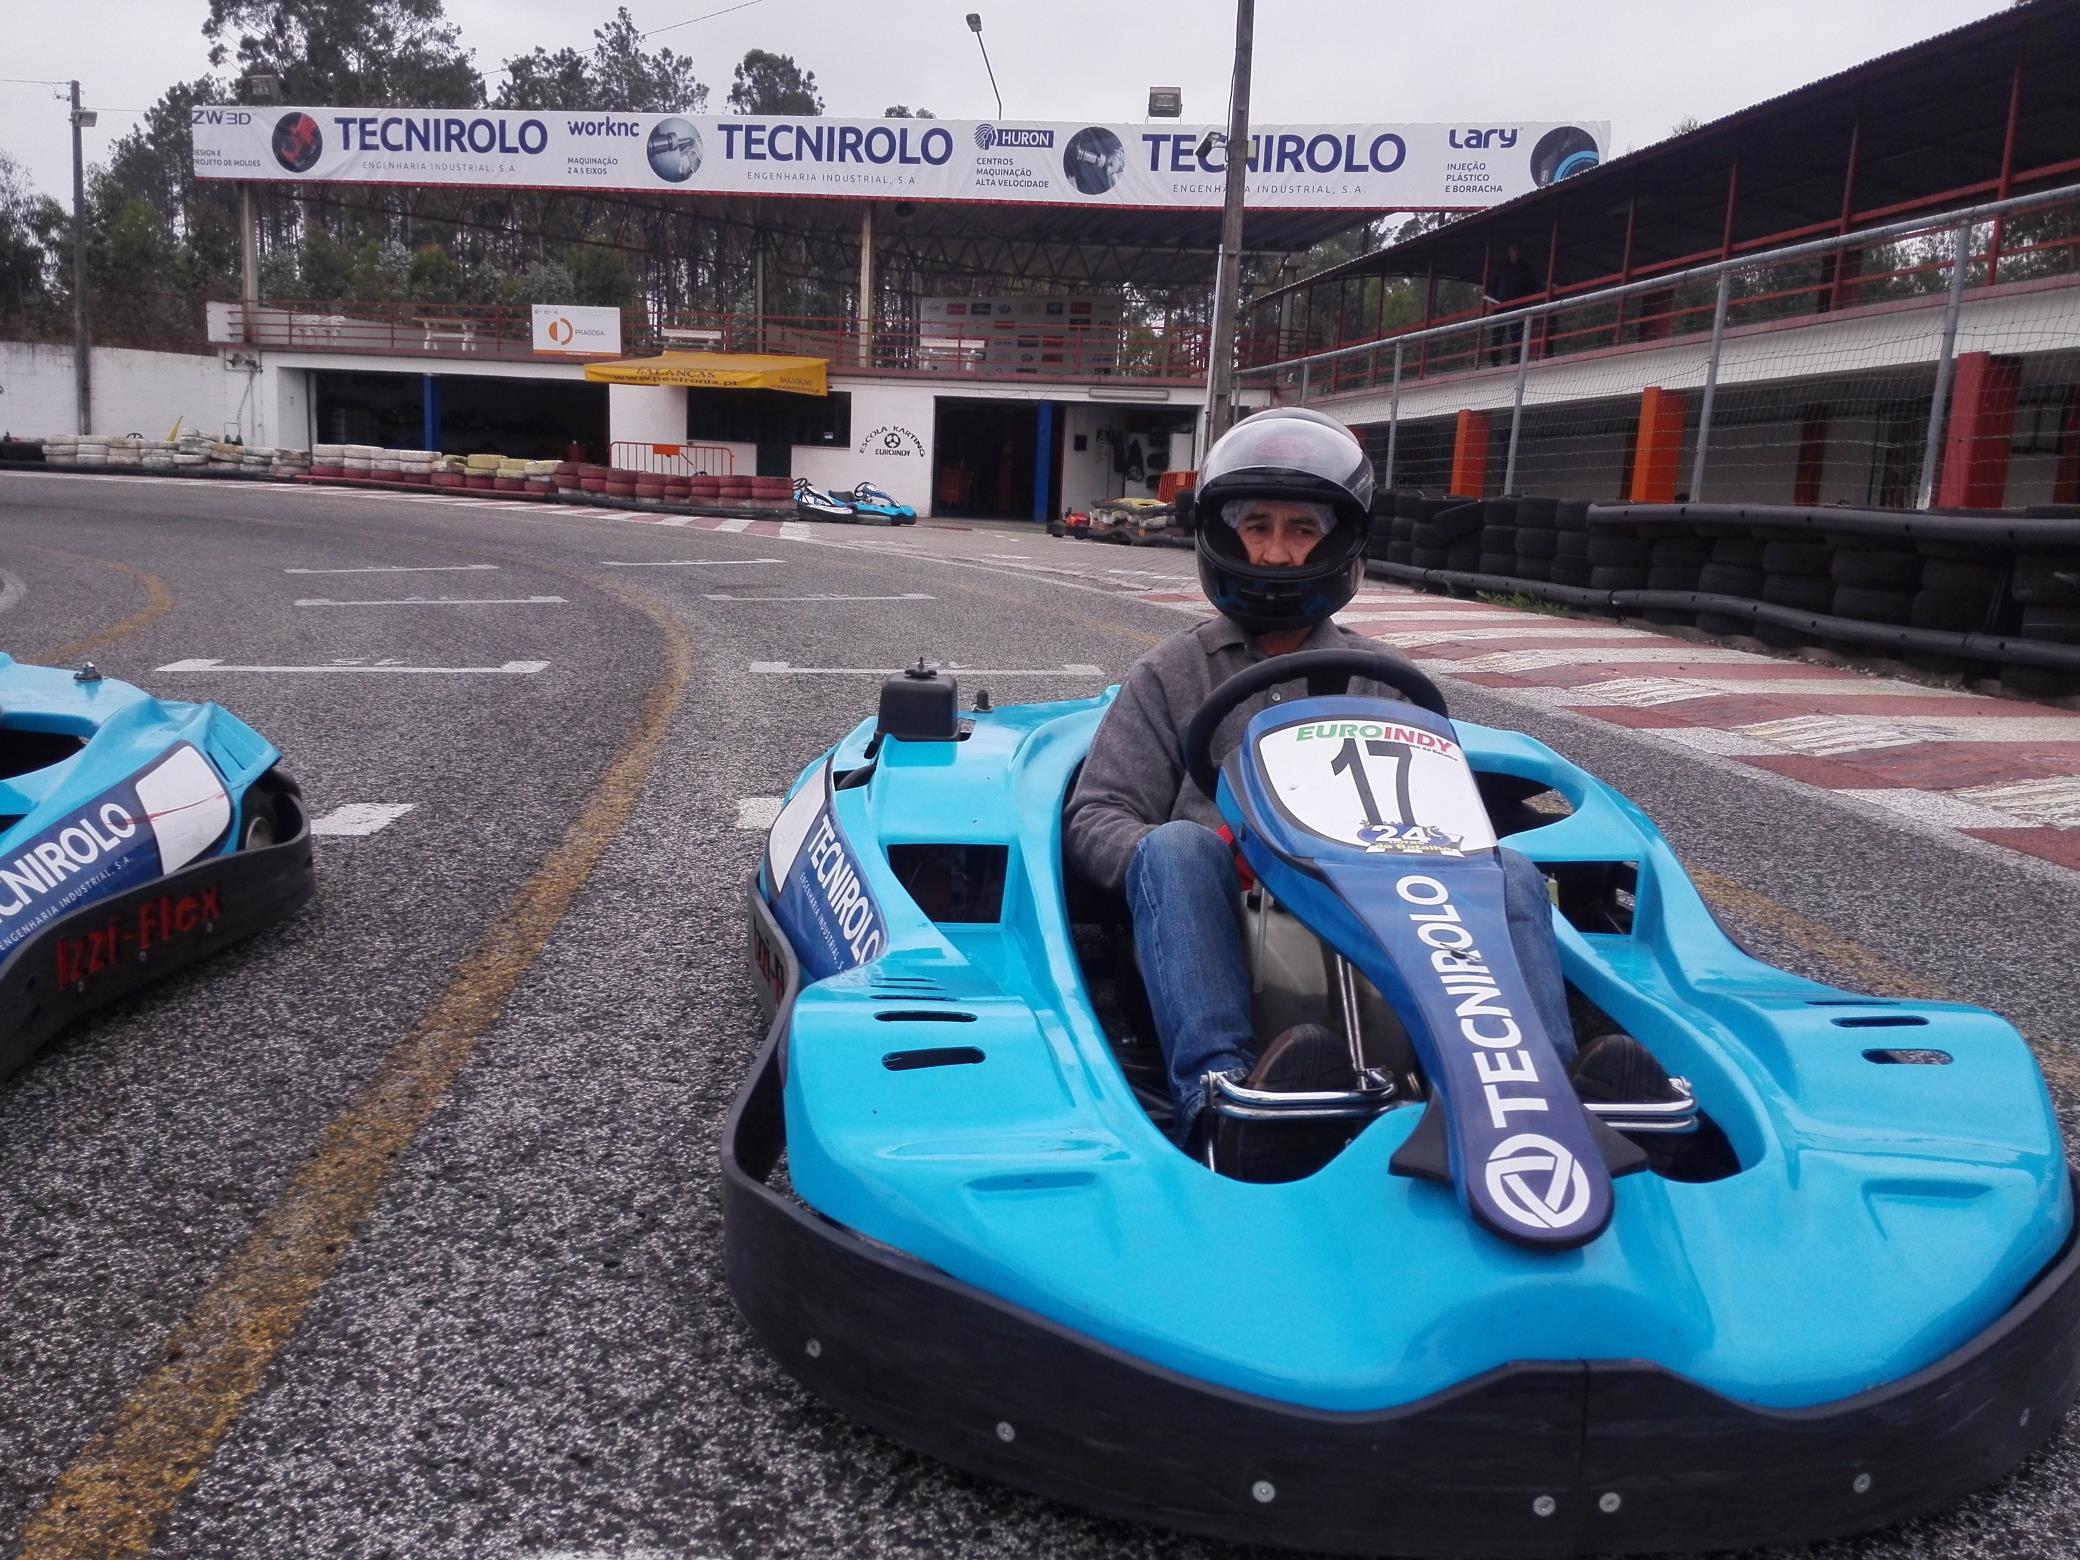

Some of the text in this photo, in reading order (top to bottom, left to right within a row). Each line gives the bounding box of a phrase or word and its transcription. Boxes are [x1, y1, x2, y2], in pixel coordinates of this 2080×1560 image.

[192, 110, 252, 125] ZW3D
[567, 116, 640, 137] worknc
[334, 117, 548, 155] TECNIROLO
[1002, 131, 1049, 146] HURON
[717, 123, 953, 165] TECNIROLO
[362, 161, 427, 170] ENGENHARIA
[567, 157, 619, 166] MAQUINAÇÃO
[976, 157, 1014, 166] CENTROS
[1446, 161, 1486, 172] INJEÇÃO
[586, 167, 608, 175] EIXOS
[747, 171, 818, 182] ENGENHARIA
[976, 168, 1032, 178] MAQUINAÇÃO
[1446, 172, 1490, 181] PLÁSTICO
[997, 179, 1049, 188] VELOCIDADE
[1445, 185, 1503, 193] E BORRACHA
[859, 425, 926, 458] ESCOLA KARTING
[875, 448, 911, 457] EUROINDY
[1296, 724, 1454, 754] EUROINDY
[1330, 737, 1417, 827] 17
[1371, 824, 1432, 844] 24
[808, 813, 880, 966] TECNIROLO
[0, 905, 60, 951] ENGENHARIA
[1396, 875, 1552, 1129] TECNIROLO
